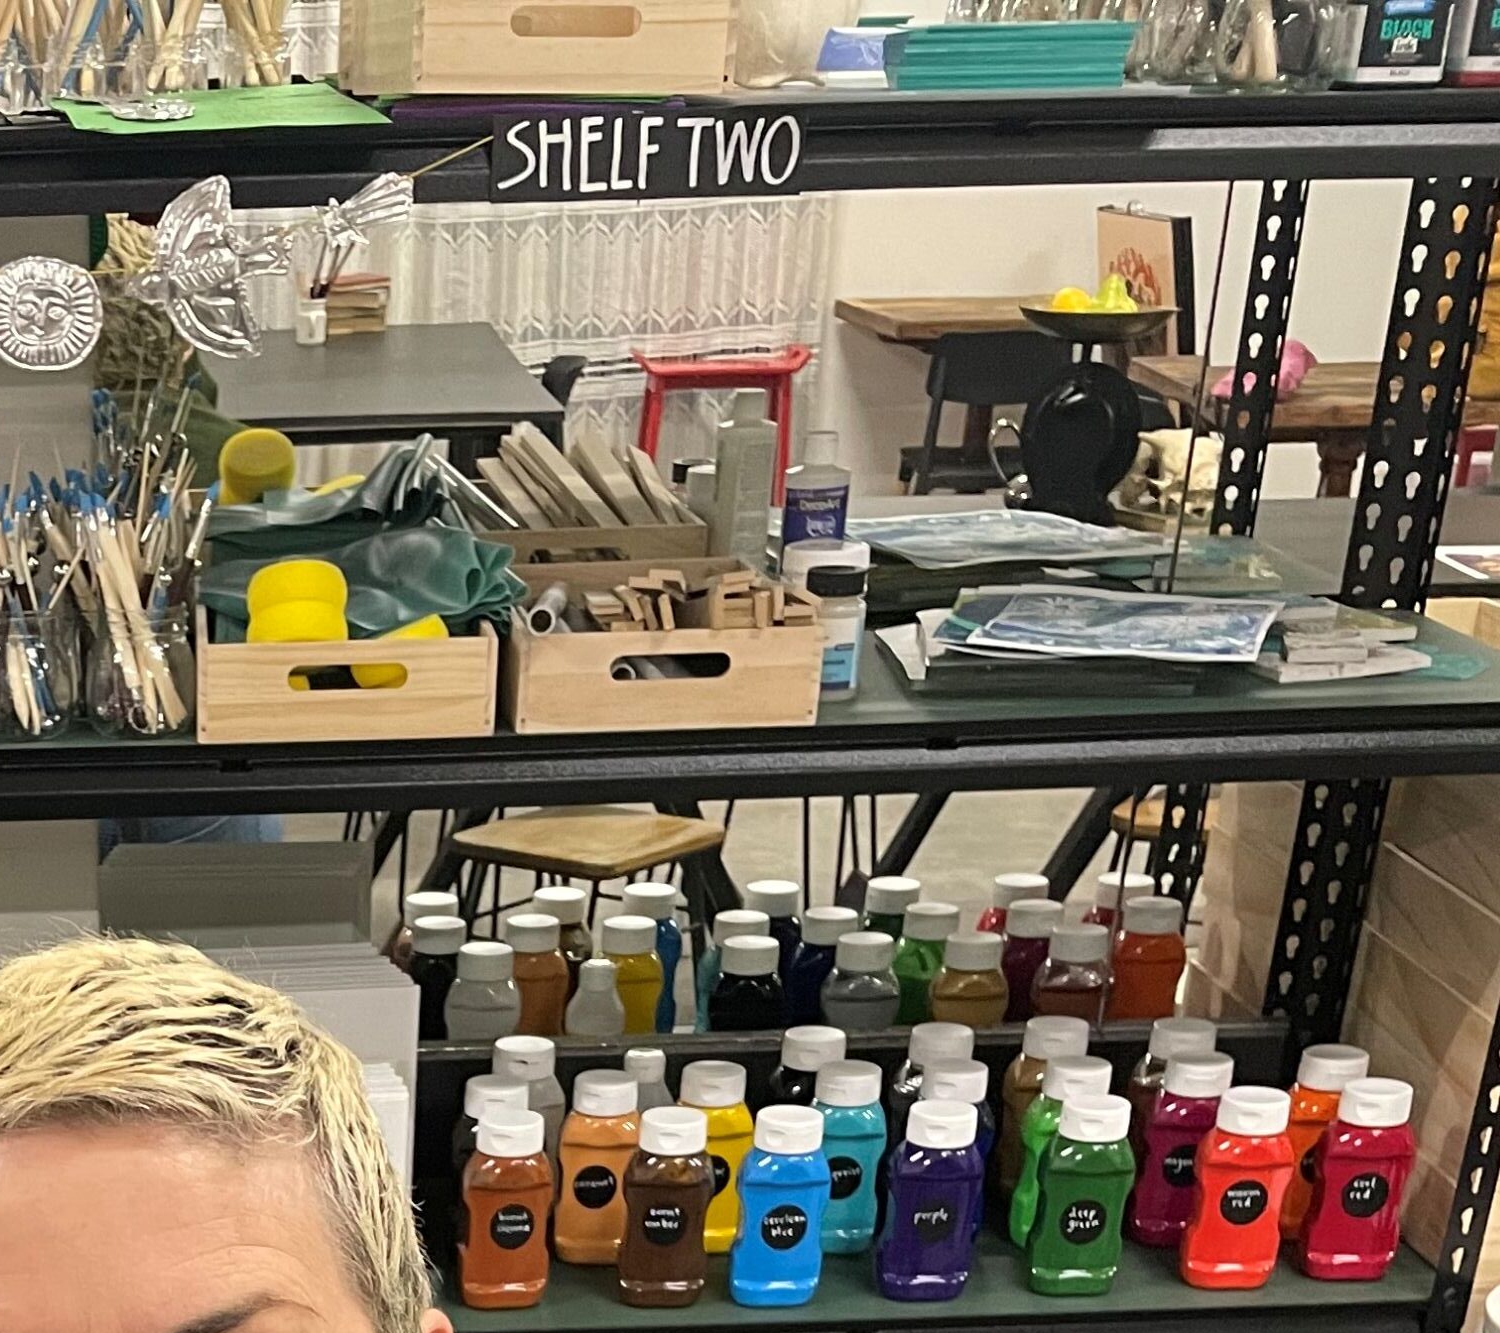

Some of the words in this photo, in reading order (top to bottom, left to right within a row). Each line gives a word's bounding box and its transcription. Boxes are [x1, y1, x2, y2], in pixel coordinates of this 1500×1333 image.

[1381, 19, 1434, 39] BLOCK
[497, 116, 663, 192] SHELF
[676, 115, 800, 187] TWO
